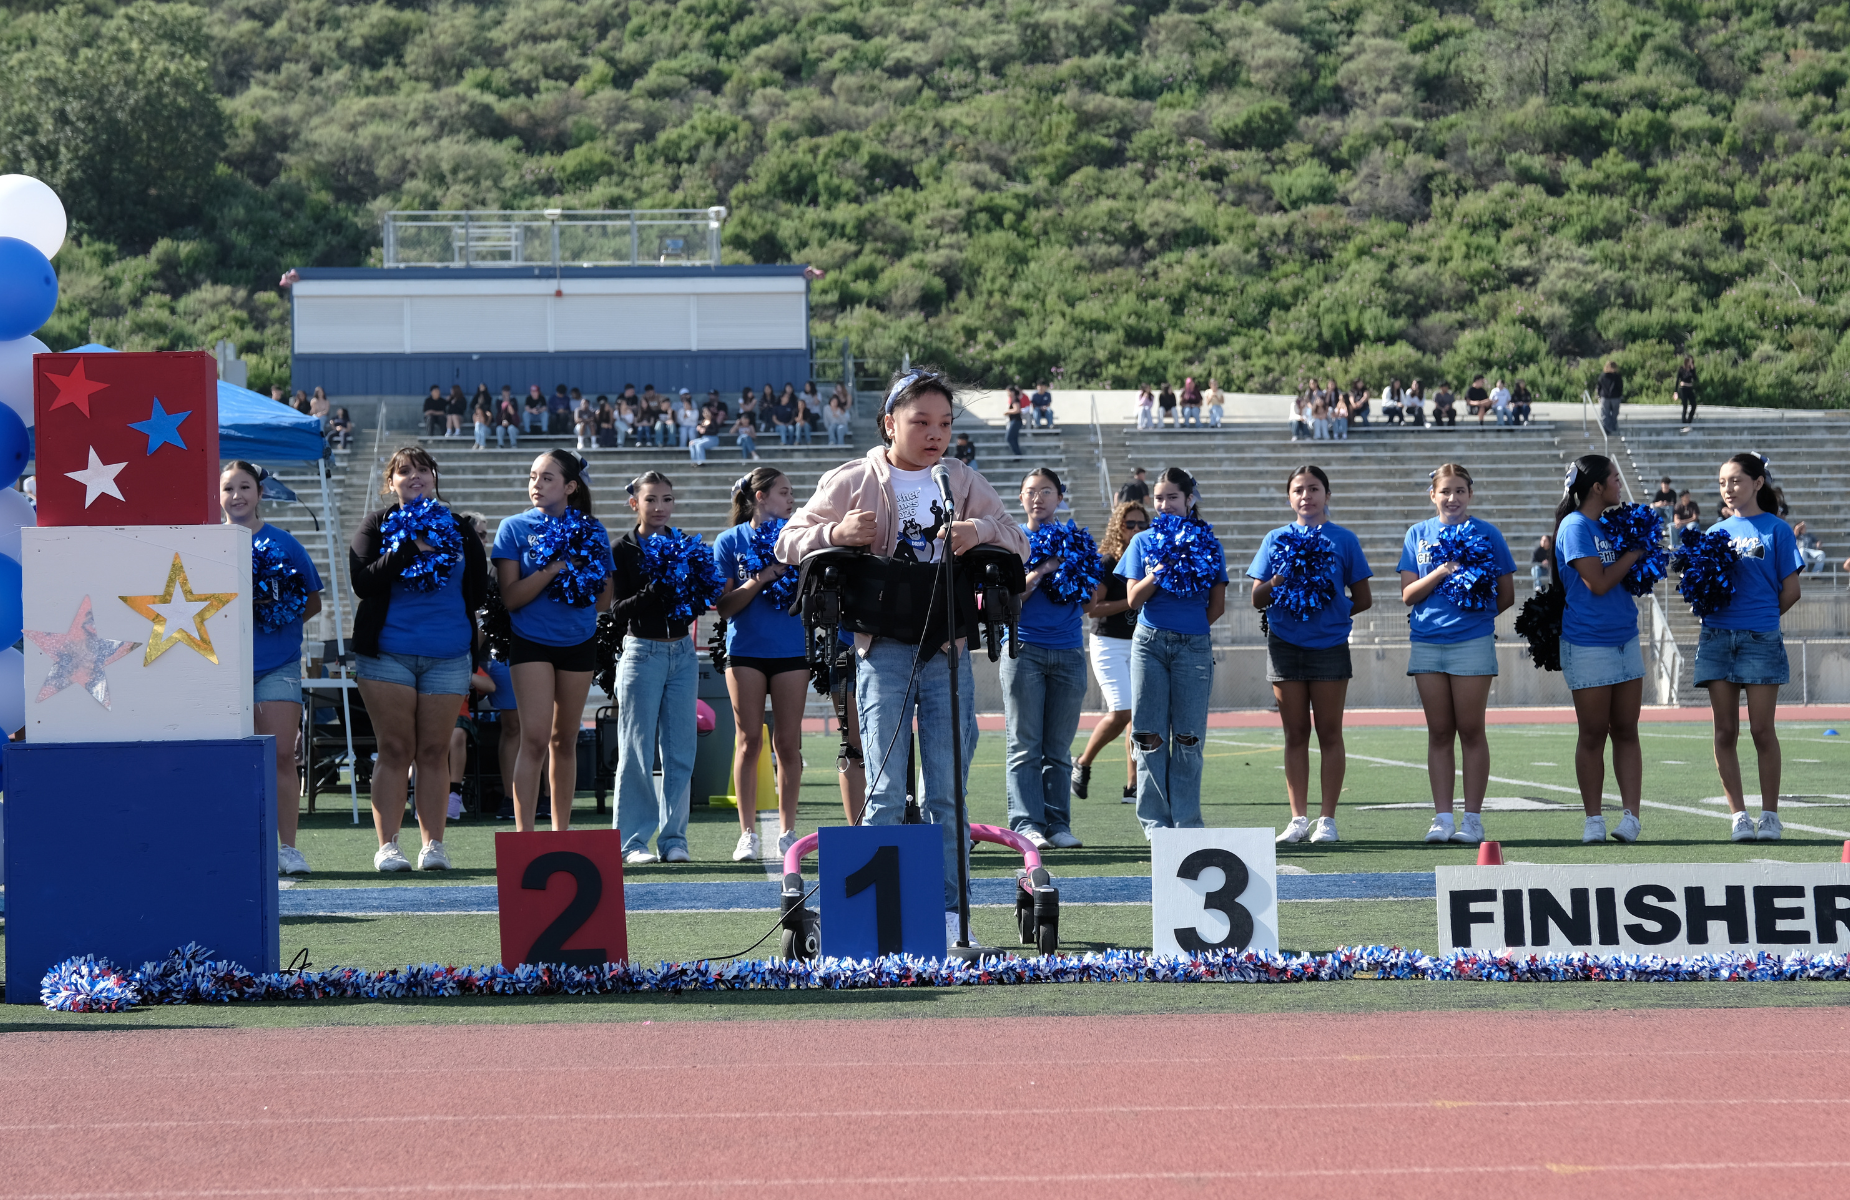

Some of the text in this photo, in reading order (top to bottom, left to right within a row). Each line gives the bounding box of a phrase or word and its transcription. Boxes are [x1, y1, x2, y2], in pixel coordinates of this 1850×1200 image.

[521, 851, 608, 964] 2
[845, 846, 902, 957] 1
[1174, 848, 1254, 957] 3
[1450, 884, 1850, 947] FINISHER
